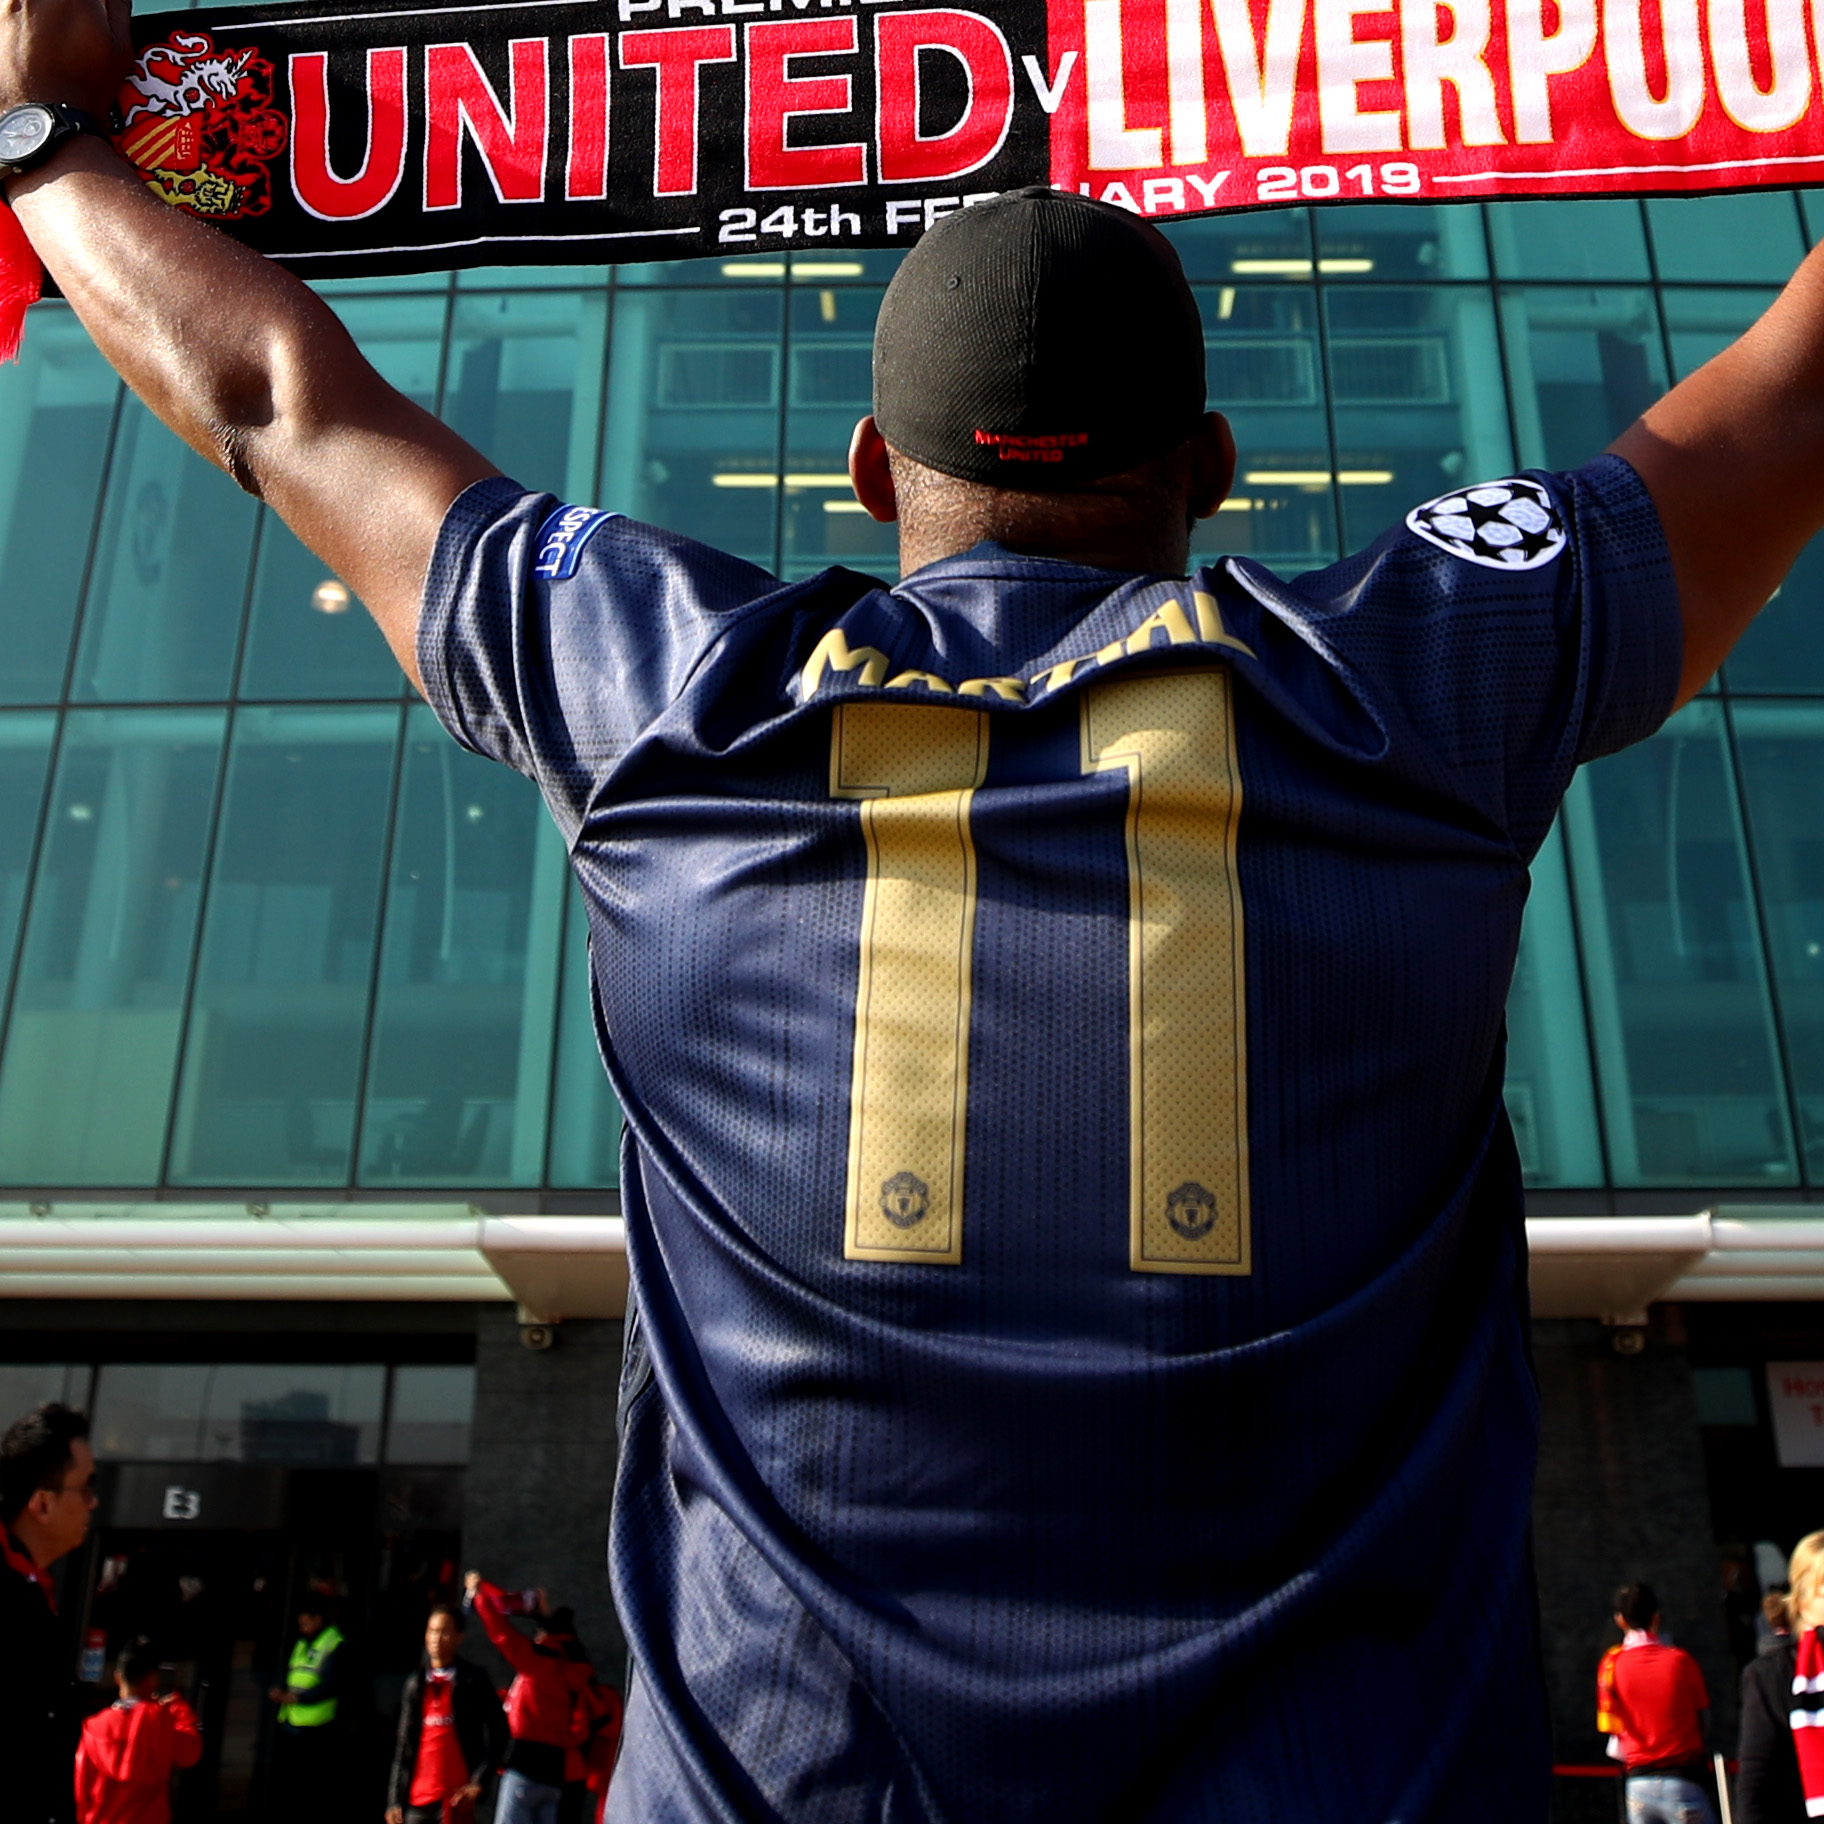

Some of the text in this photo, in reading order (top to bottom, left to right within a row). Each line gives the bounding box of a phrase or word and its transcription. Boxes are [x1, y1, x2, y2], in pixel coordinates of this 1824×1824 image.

[288, 8, 1014, 222] UNITED
[718, 163, 1422, 244] 24th FEARY 2019
[974, 429, 1088, 447] MANCHESTER
[999, 447, 1063, 462] UNITED
[831, 666, 1253, 1278] 11
[162, 1485, 201, 1519] E3
